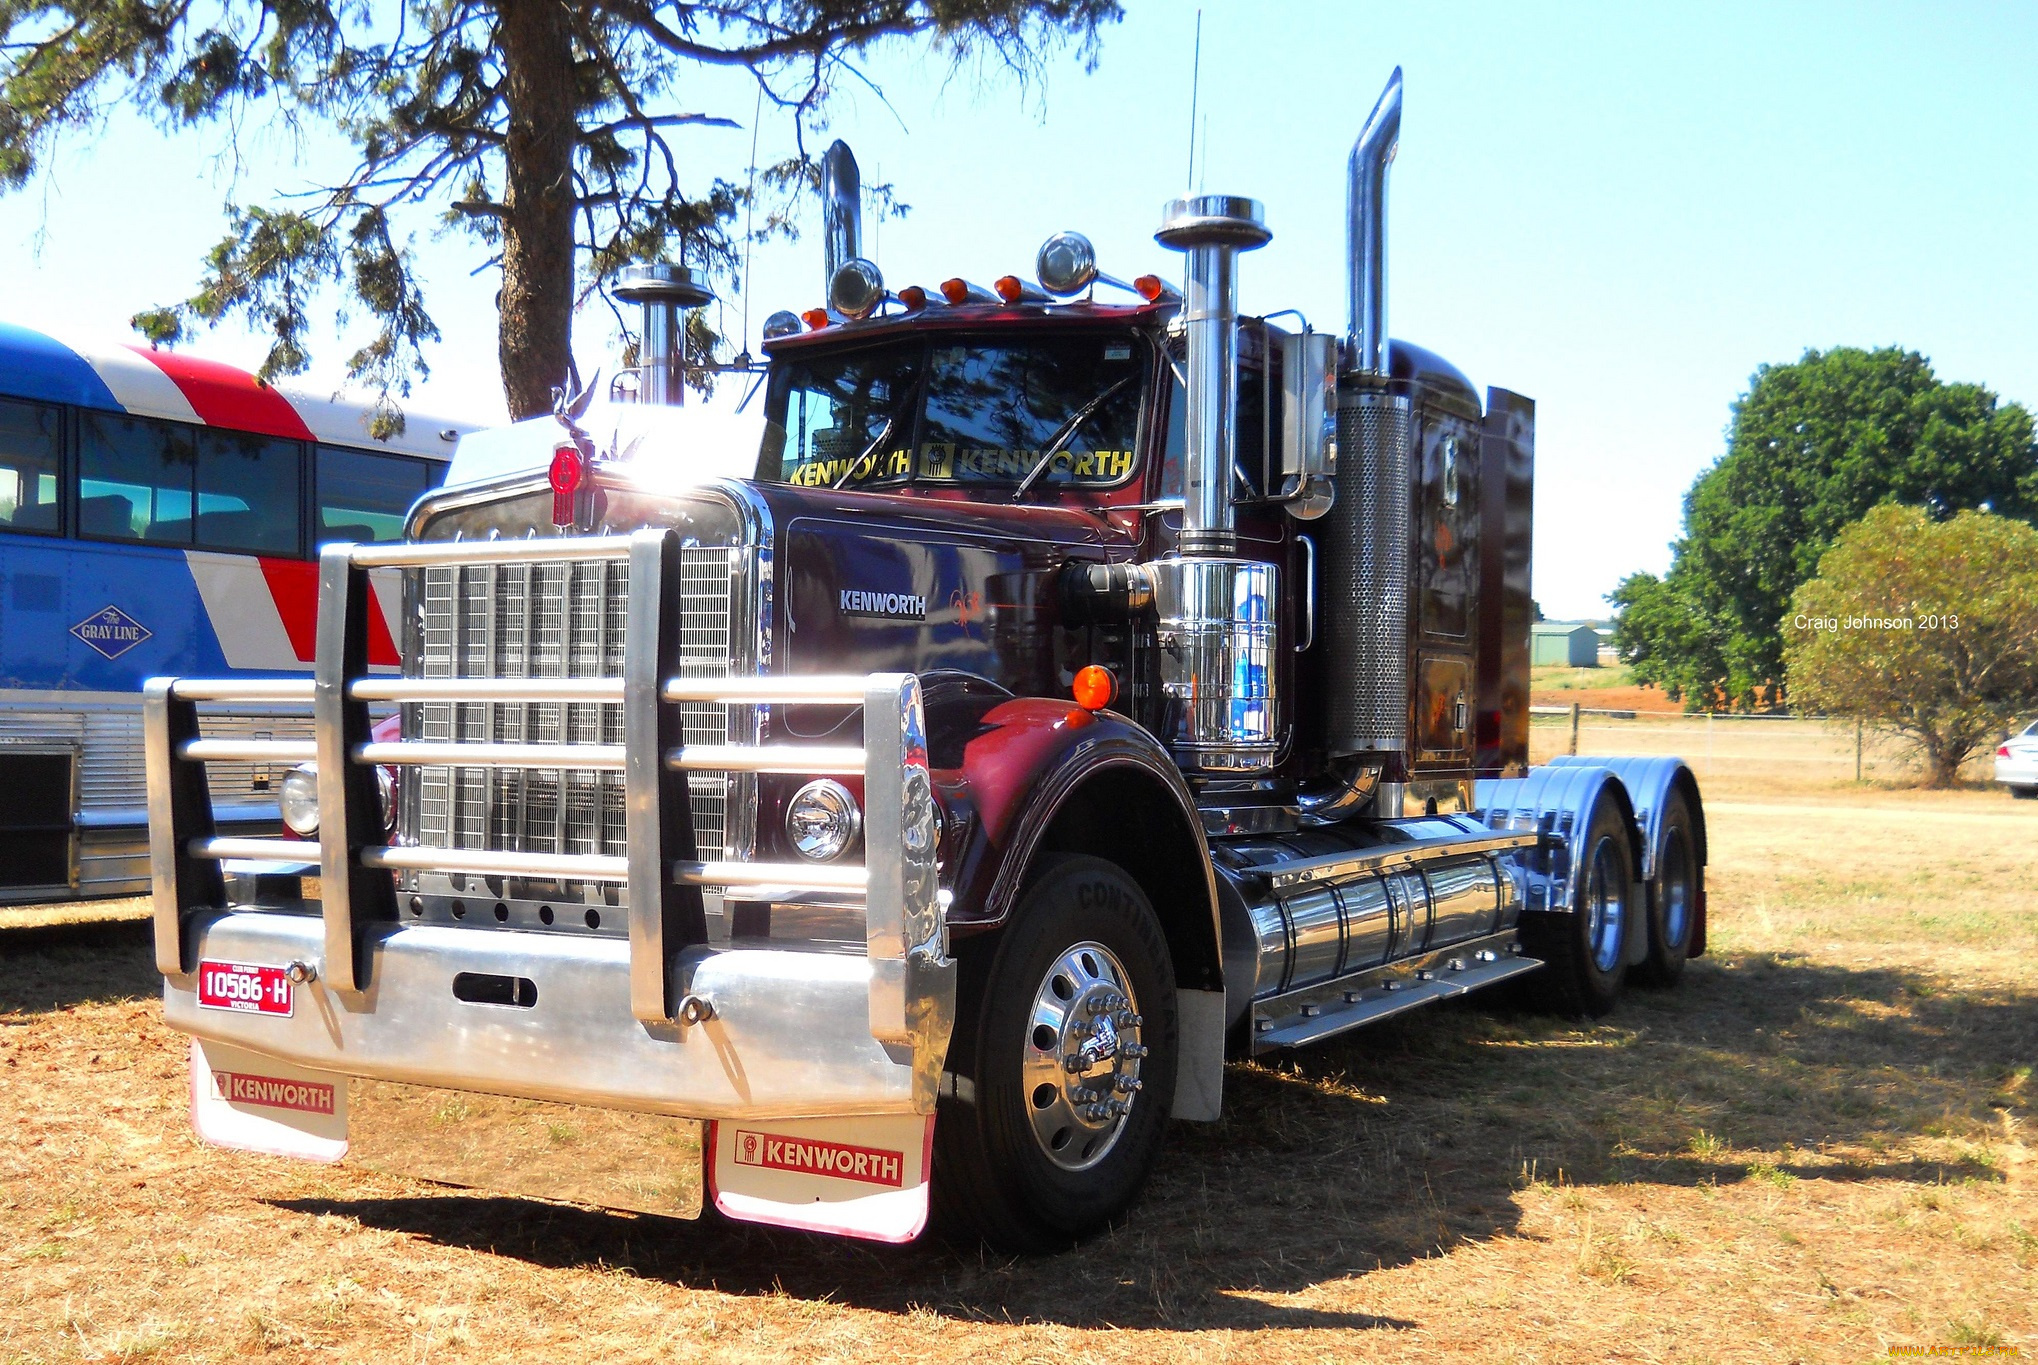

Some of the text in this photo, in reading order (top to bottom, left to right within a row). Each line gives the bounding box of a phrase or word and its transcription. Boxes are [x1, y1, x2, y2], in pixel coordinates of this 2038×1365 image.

[959, 449, 1132, 476] KENWORTH
[840, 589, 926, 615] KENWORTH
[102, 611, 120, 625] The
[81, 624, 139, 640] GRAY LINE
[230, 1000, 259, 1010] VICTORIA
[233, 1078, 331, 1109] KENWORTH
[767, 1140, 899, 1181] KENWORTH
